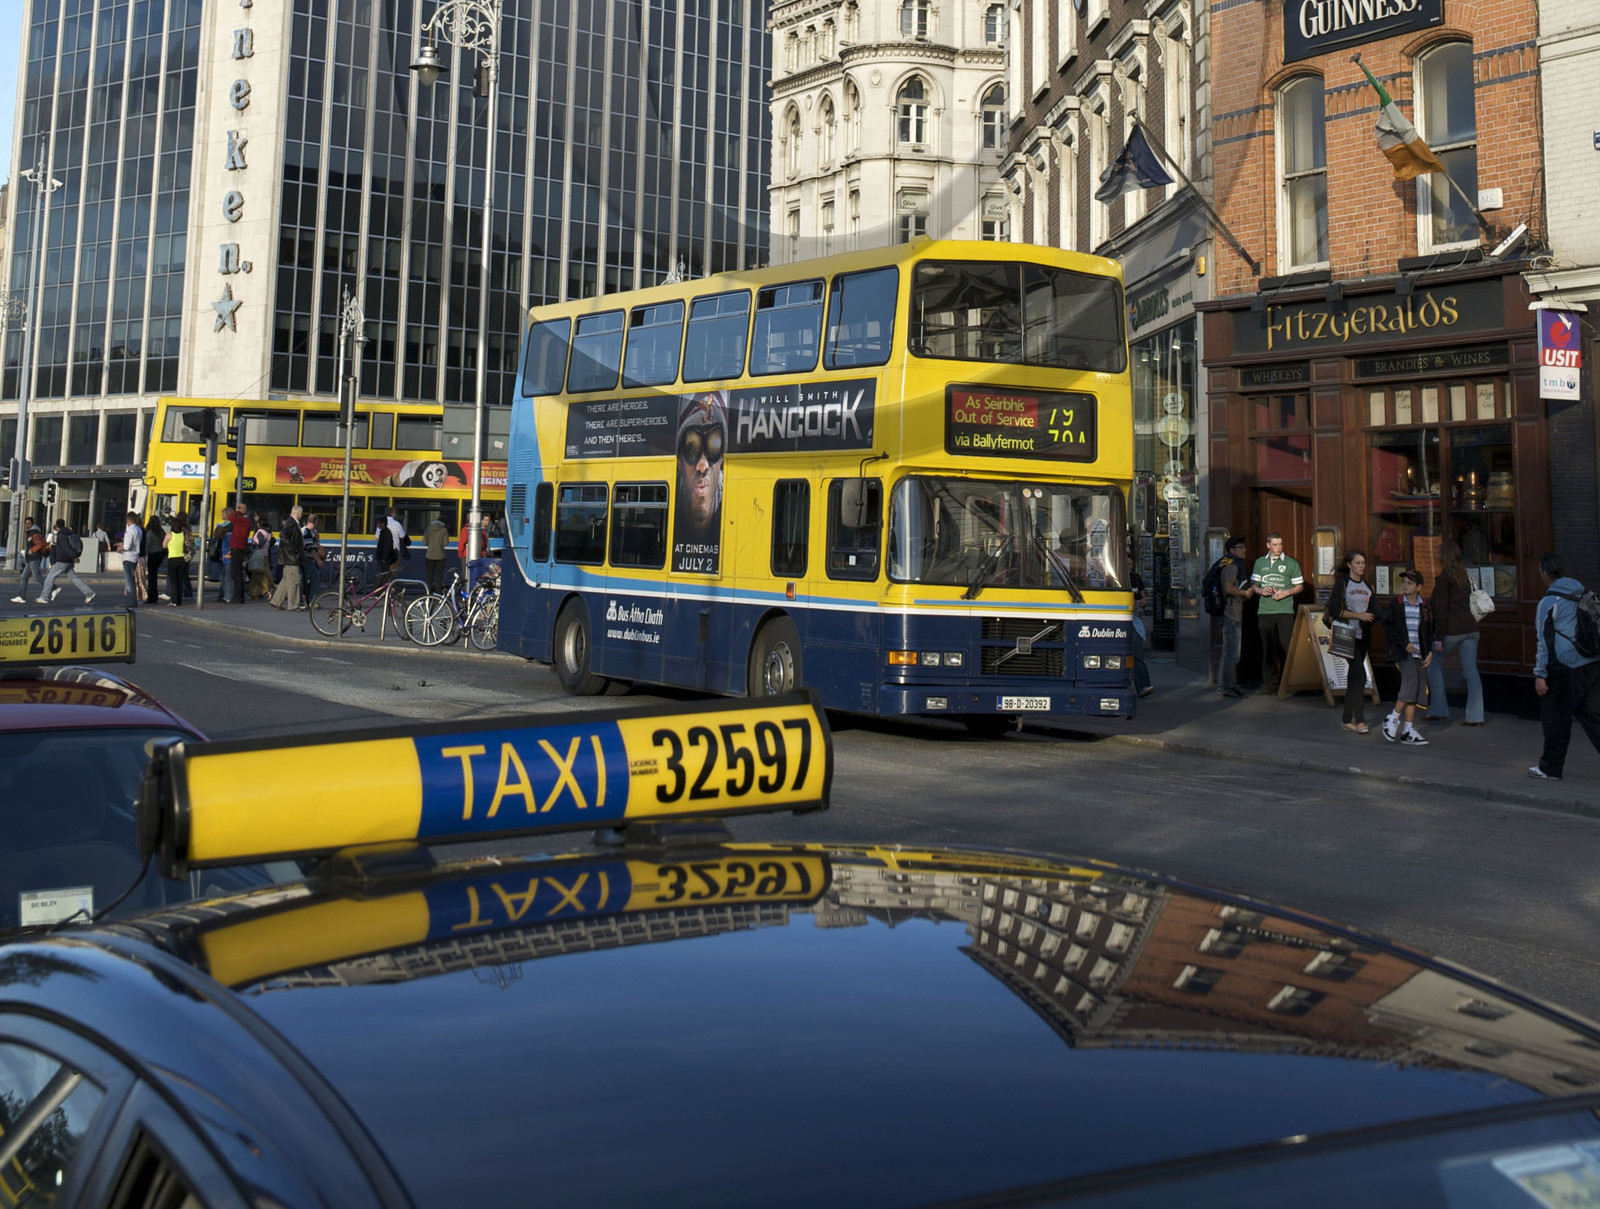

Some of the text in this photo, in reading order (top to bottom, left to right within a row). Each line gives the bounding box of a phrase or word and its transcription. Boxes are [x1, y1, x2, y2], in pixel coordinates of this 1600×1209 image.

[1375, 351, 1490, 373] BRANDIES & WINES
[1544, 348, 1579, 367] USIT
[1252, 368, 1303, 383] WHISKEYS
[761, 391, 838, 404] WILL SMITH
[965, 395, 1025, 412] As Seirbhís
[587, 400, 649, 413] THERE ARE HEROES.
[585, 416, 669, 429] THERE ARE SUPERHEROES.
[737, 388, 865, 445] HANCOCK
[954, 409, 1035, 428] Out of Service
[584, 436, 598, 445] AND
[598, 435, 615, 444] THEN
[954, 432, 1035, 451] via Ballyfermot
[310, 469, 374, 483] PANDA
[480, 477, 508, 486] EGINS
[674, 543, 719, 554] AT CINEMAS
[679, 557, 713, 572] JULY 2
[617, 605, 629, 621] Bus
[0, 630, 28, 639] LICENCE
[29, 615, 116, 655] 26116
[607, 628, 660, 644] www.dublinbus.ie
[1091, 627, 1127, 639] Dublin Bus
[0, 639, 28, 647] NUMBER
[1004, 699, 1048, 709] 98-D-20392
[652, 717, 812, 804] 32597
[441, 734, 607, 821] TAXI
[31, 899, 57, 909] DUBLIN
